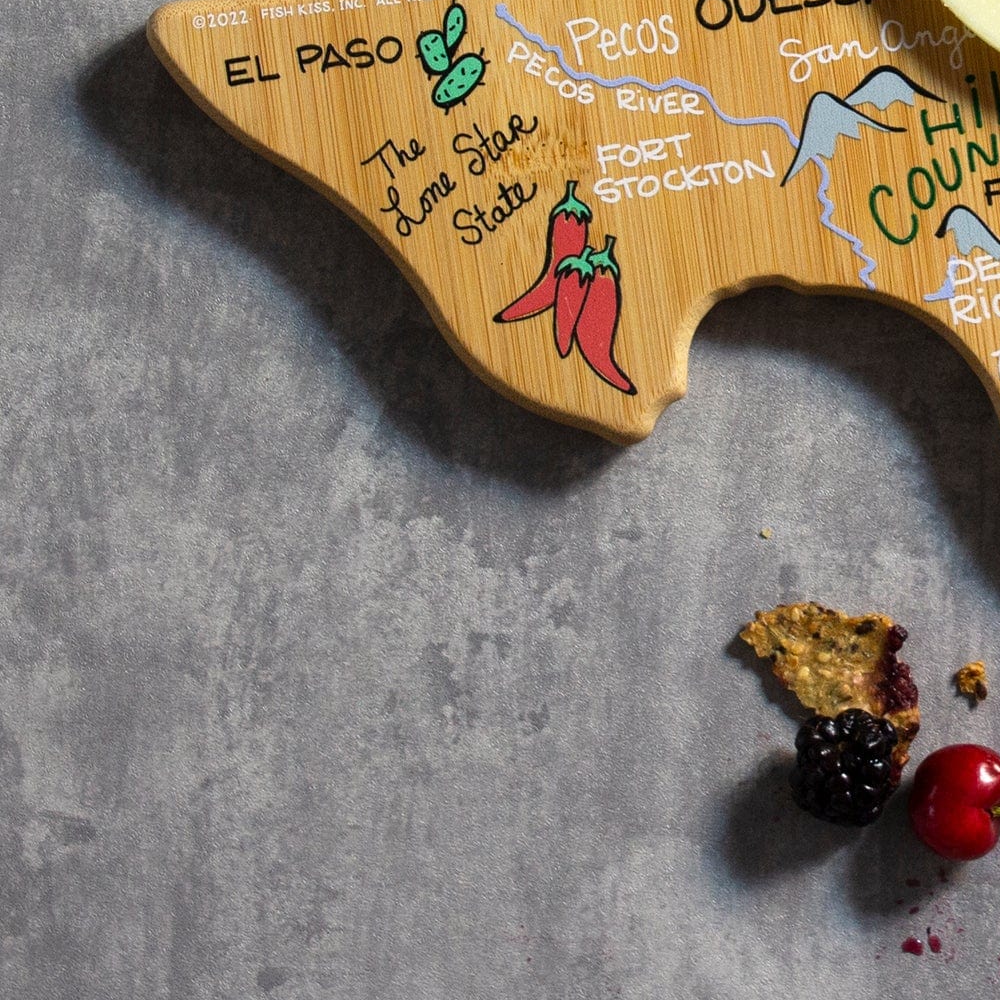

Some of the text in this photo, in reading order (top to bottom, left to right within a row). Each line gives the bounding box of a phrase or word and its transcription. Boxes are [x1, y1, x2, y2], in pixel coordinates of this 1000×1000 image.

[261, 7, 293, 19] FISH
[224, 36, 403, 86] EL PASO
[506, 41, 596, 104] PECOS
[778, 38, 879, 83] San
[361, 136, 426, 179] The
[592, 150, 777, 204] STOCKTON
[596, 132, 691, 174] FORT
[380, 171, 457, 237] Lone
[453, 178, 538, 245] State
